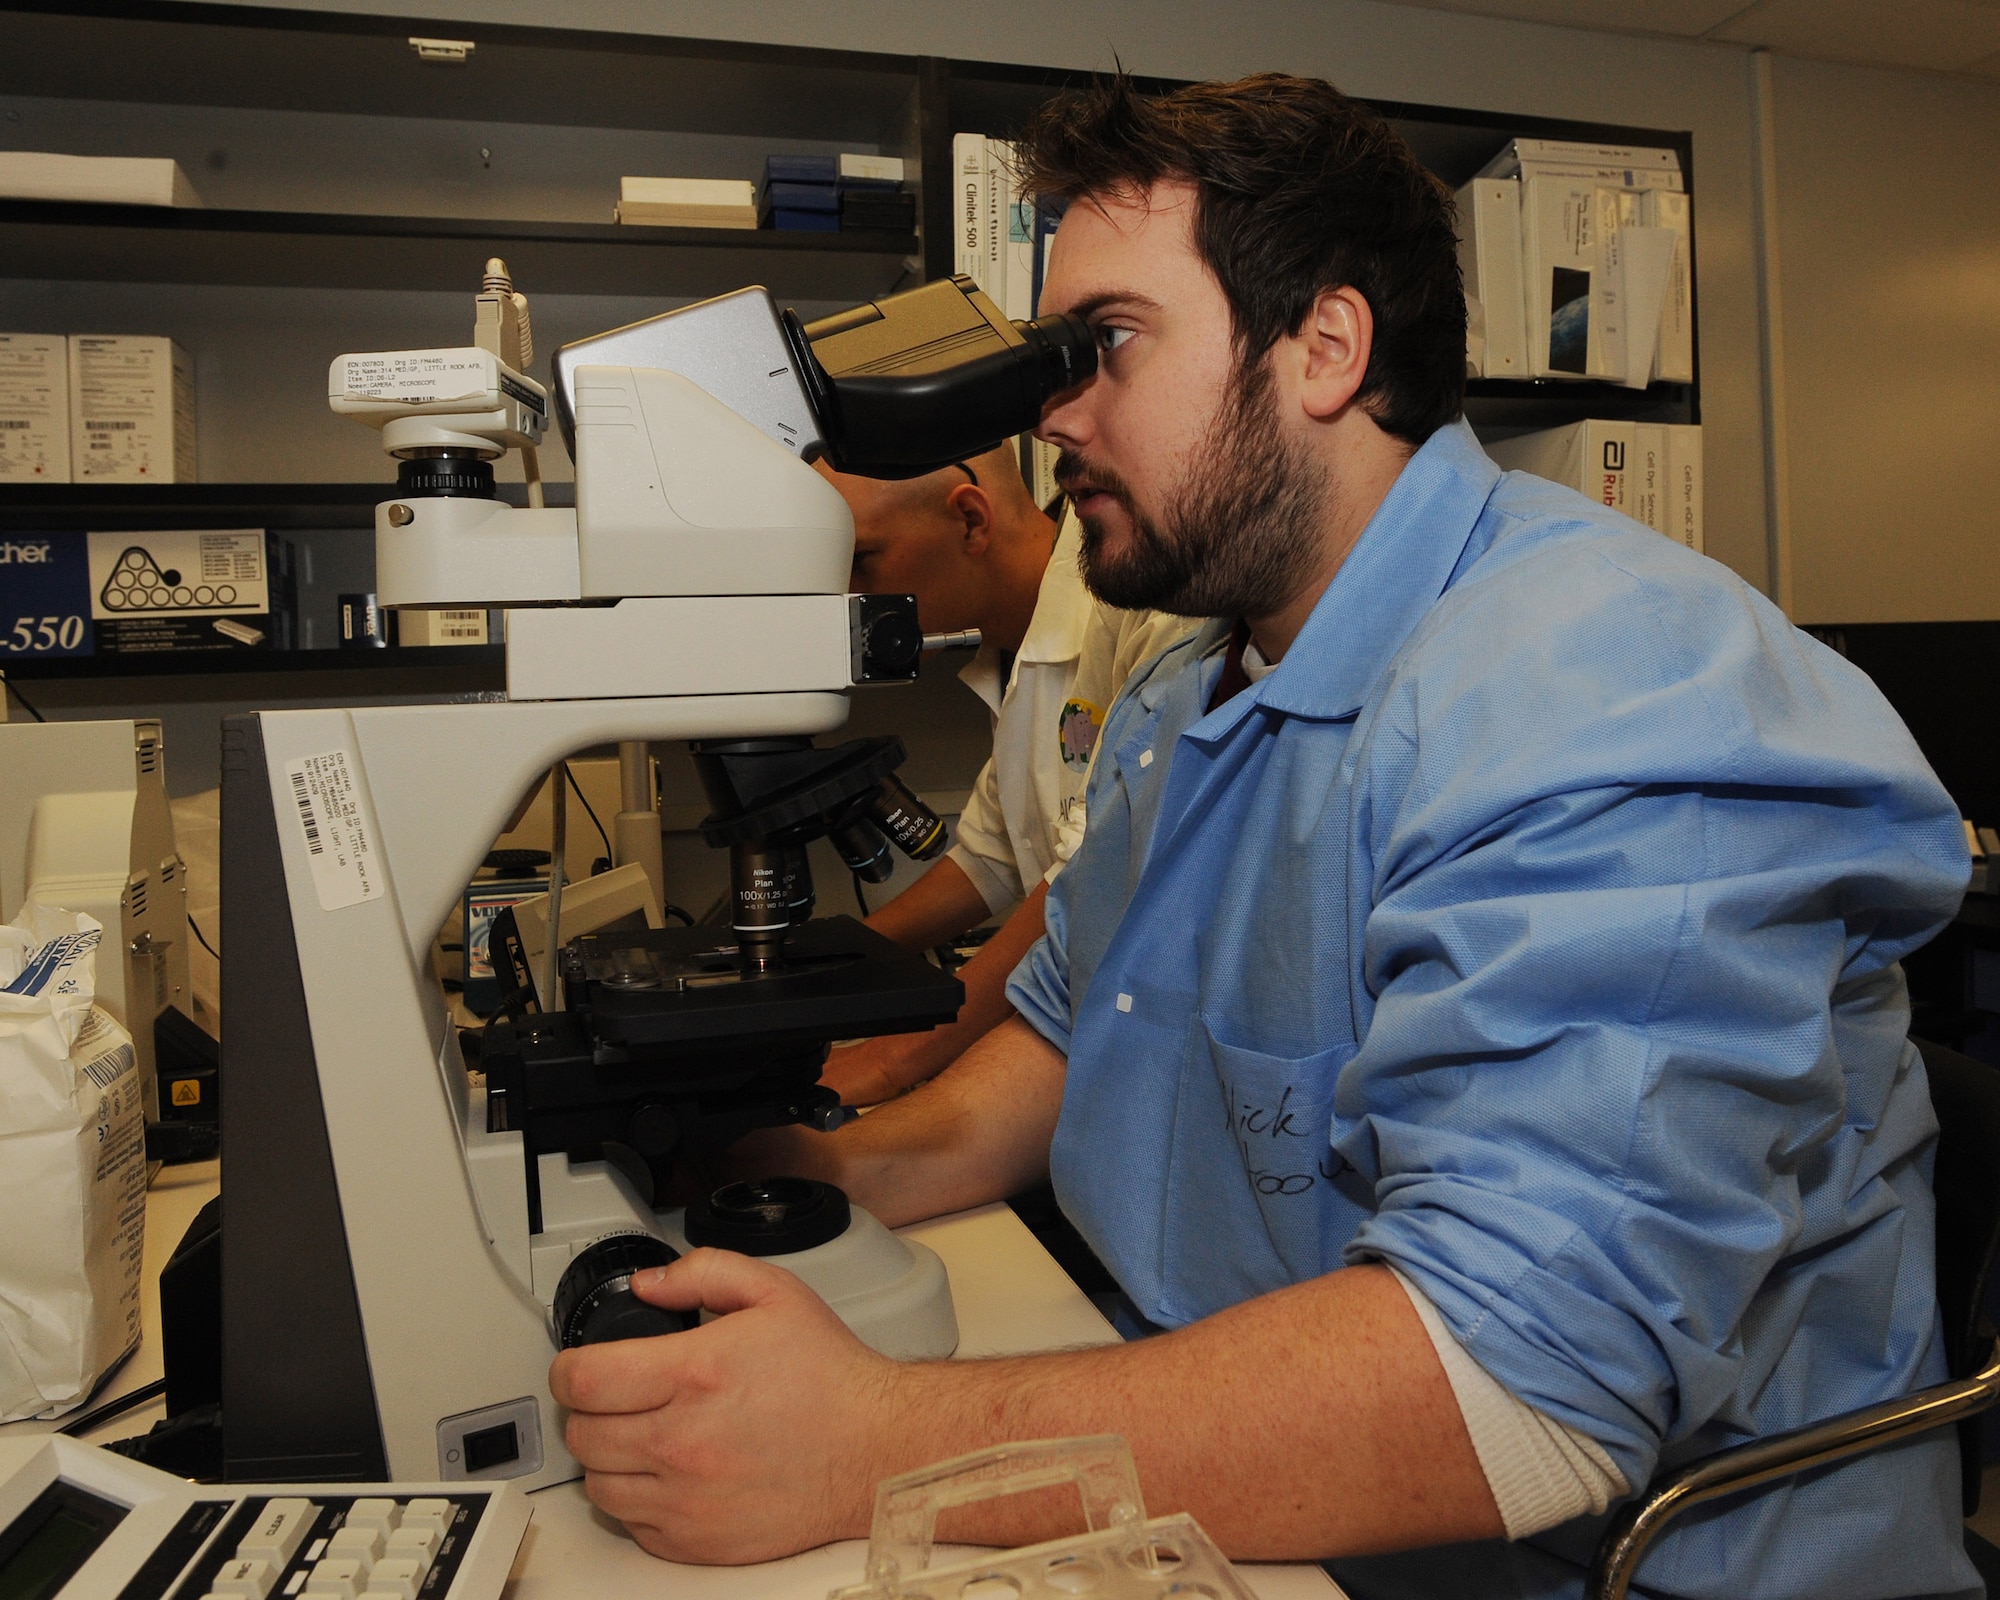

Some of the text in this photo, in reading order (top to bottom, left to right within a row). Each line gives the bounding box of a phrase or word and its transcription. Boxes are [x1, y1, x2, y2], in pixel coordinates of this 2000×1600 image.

[966, 183, 977, 223] Clinitek
[966, 227, 977, 248] 500
[1061, 345, 1071, 369] Nikon
[399, 379, 436, 387] MICROSCOPE
[1684, 465, 1693, 482] Cell
[1646, 451, 1656, 527] Cell Dyn Service
[1684, 484, 1693, 503] Dyn
[886, 808, 903, 825] Nikon
[893, 816, 910, 831] Plan
[337, 853, 347, 867] LAB
[349, 834, 361, 858] LITTLE
[356, 861, 367, 878] ROCK
[752, 869, 774, 877] Nikon
[754, 879, 774, 888] Plan
[266, 1513, 287, 1536] CLEAR
